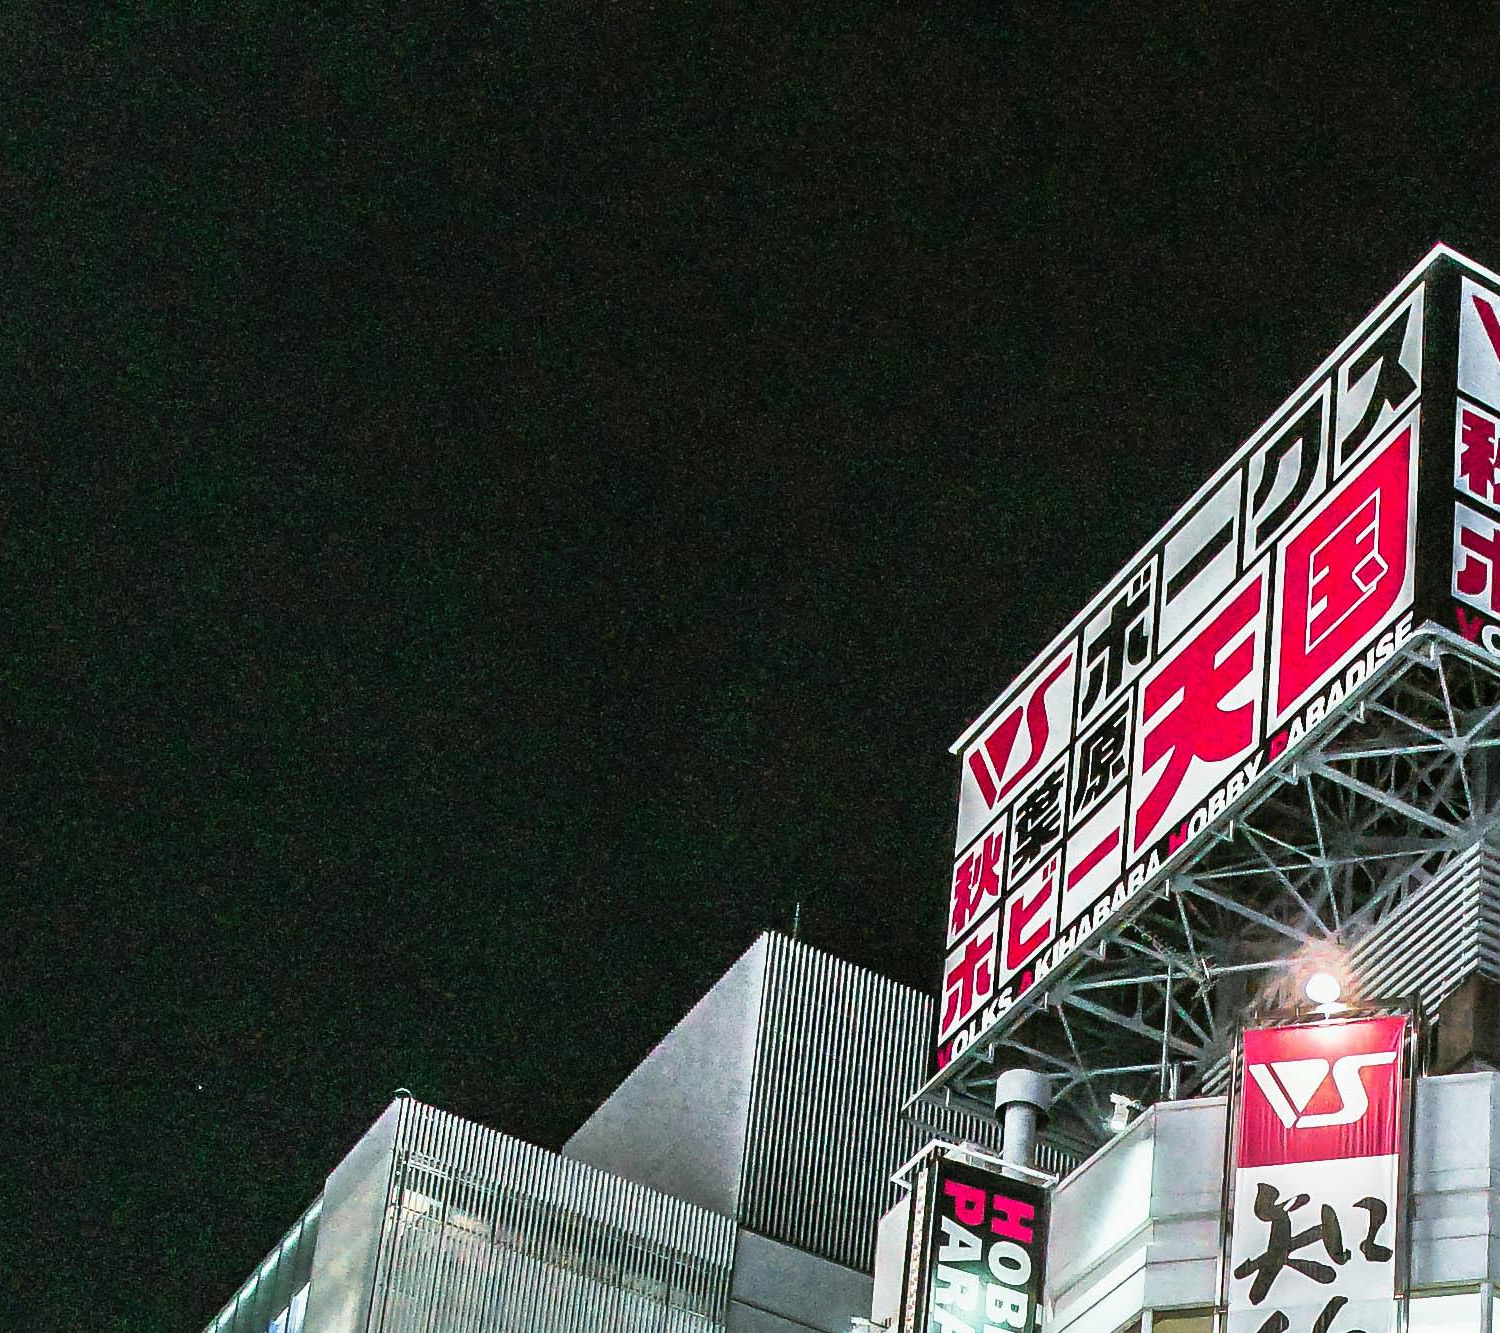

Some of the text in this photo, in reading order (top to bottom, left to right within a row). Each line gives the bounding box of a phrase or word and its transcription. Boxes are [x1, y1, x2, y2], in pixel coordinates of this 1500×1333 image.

[937, 610, 1416, 1069] VOLKS AKIHABARA HOBBY PARADISE
[951, 705, 1129, 936] 秋葉原
